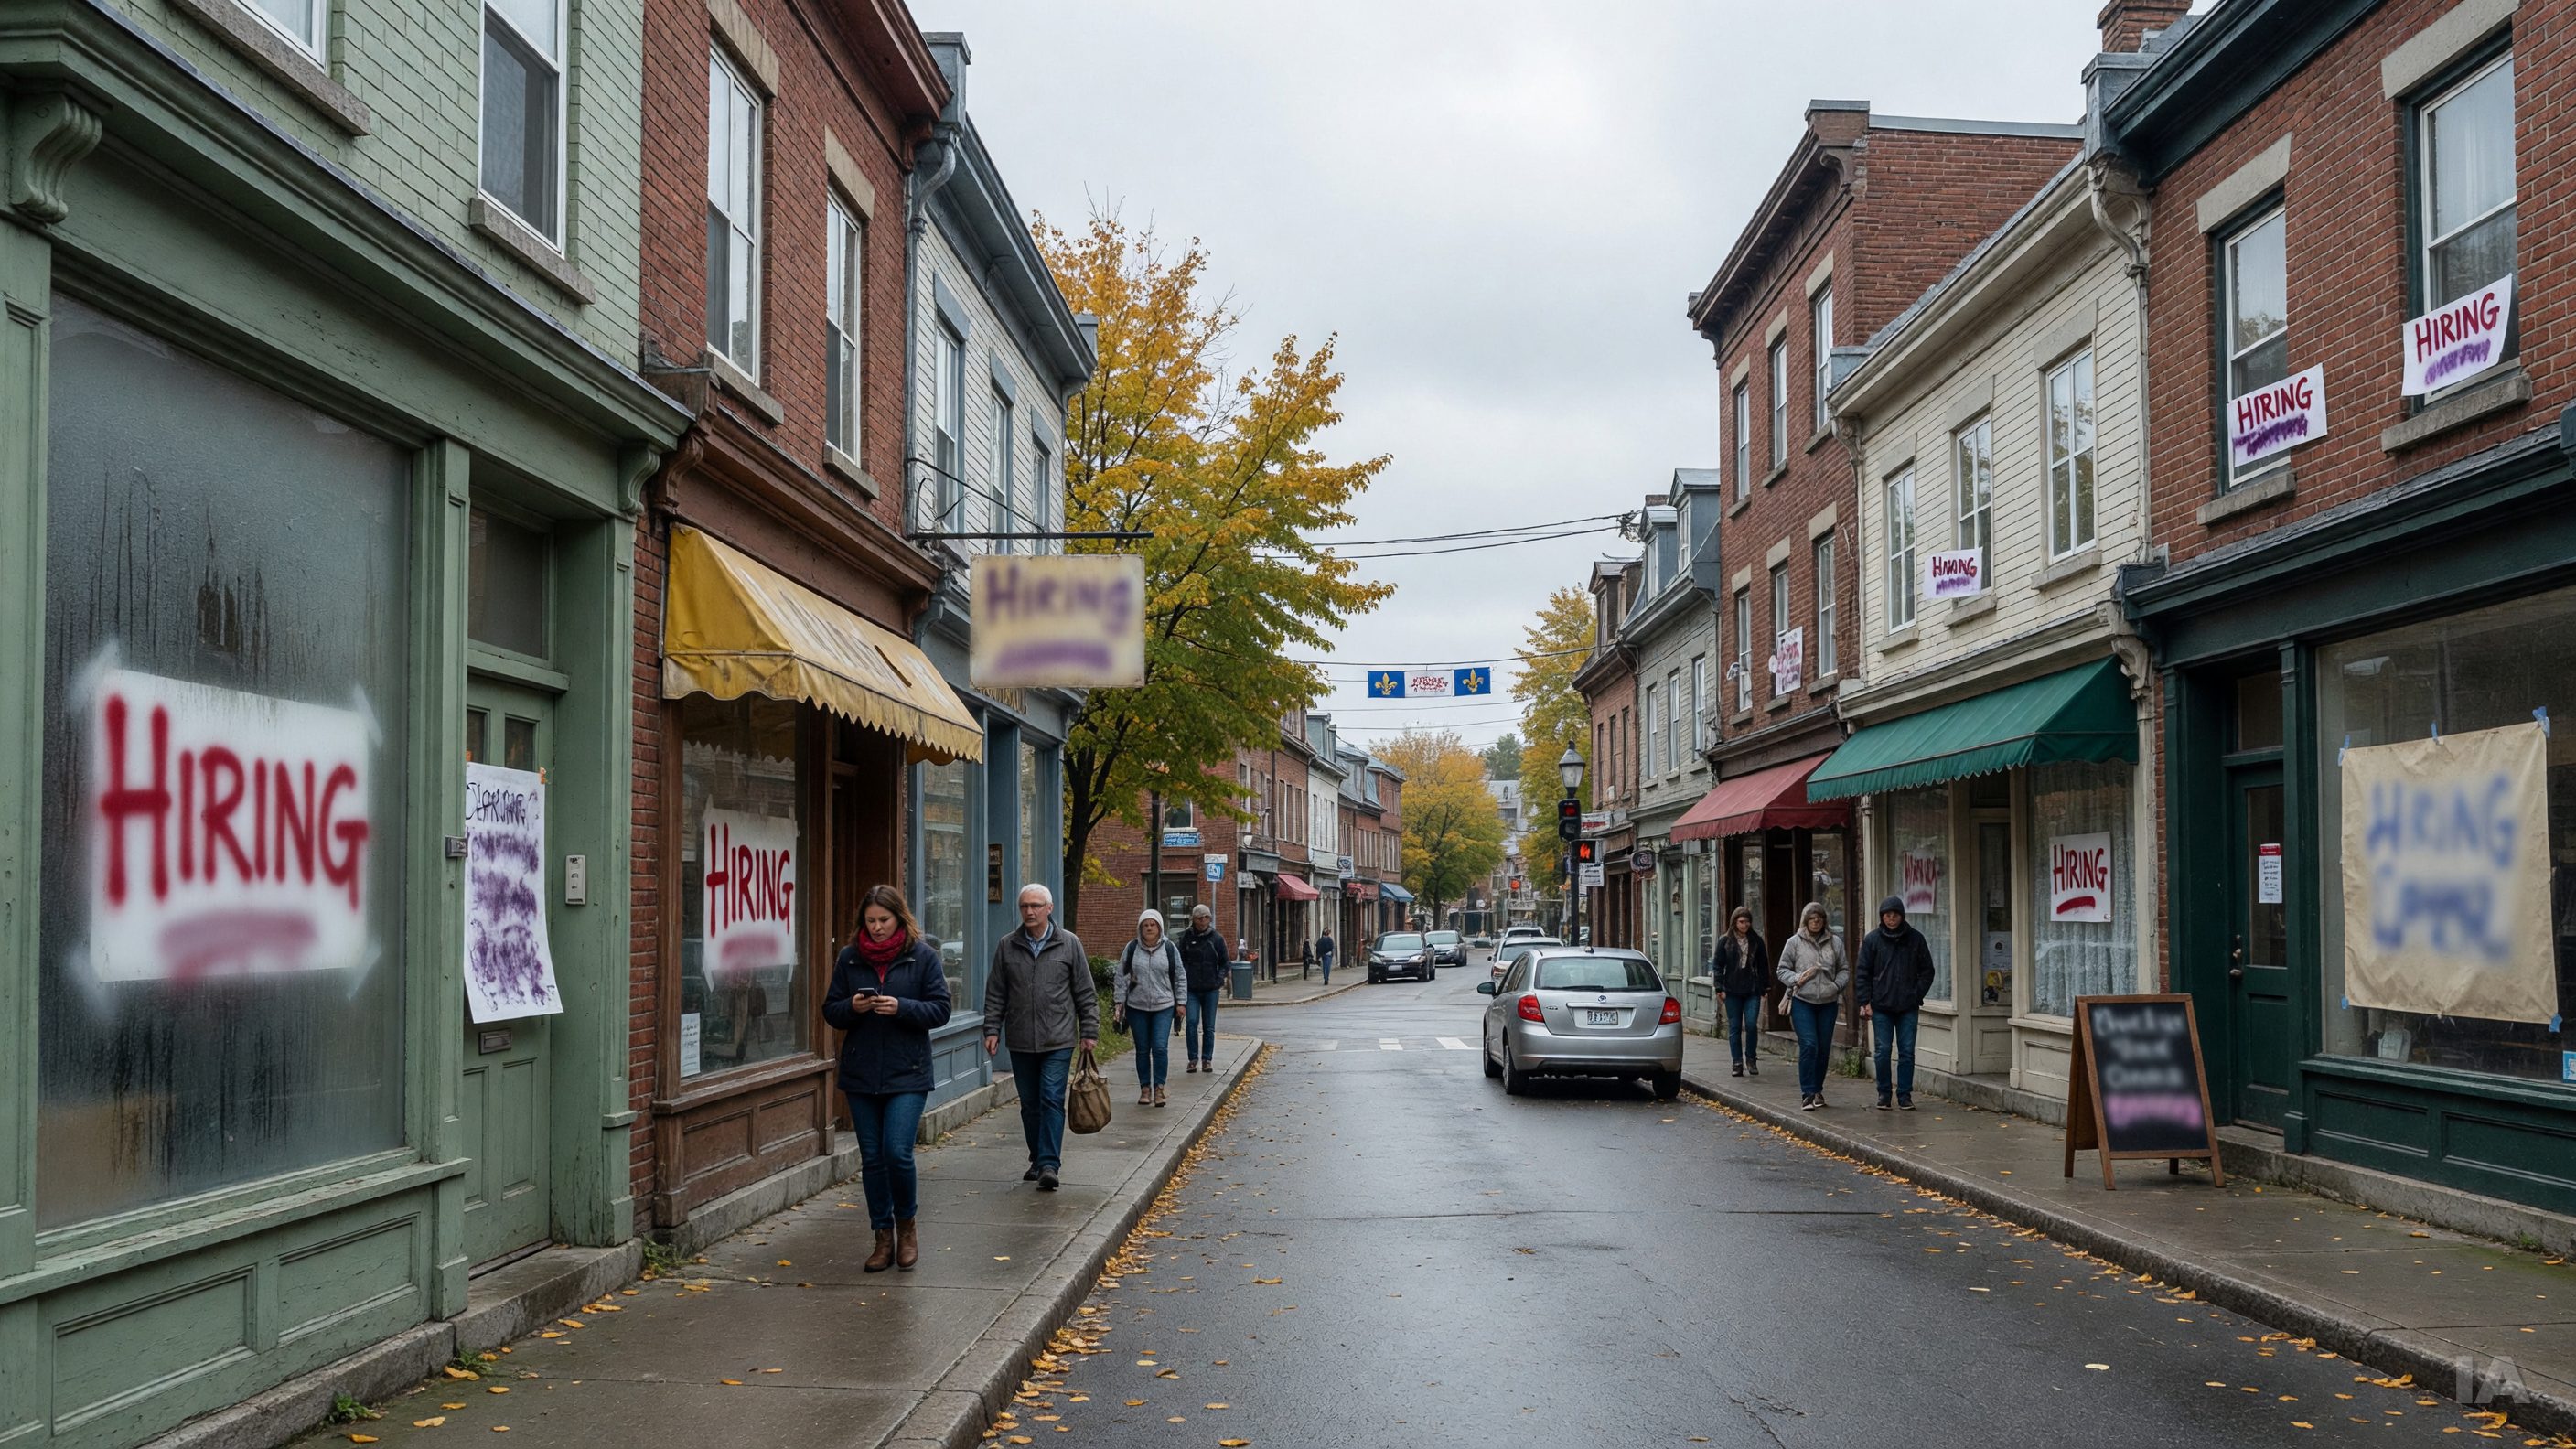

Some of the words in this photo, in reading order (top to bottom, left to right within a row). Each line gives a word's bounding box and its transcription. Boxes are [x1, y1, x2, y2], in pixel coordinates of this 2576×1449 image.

[2415, 292, 2500, 363] HIRING
[2237, 376, 2313, 435] HIRING
[98, 692, 370, 912] HIRING
[706, 822, 794, 939] HIRING
[2053, 843, 2108, 895] HIRING
